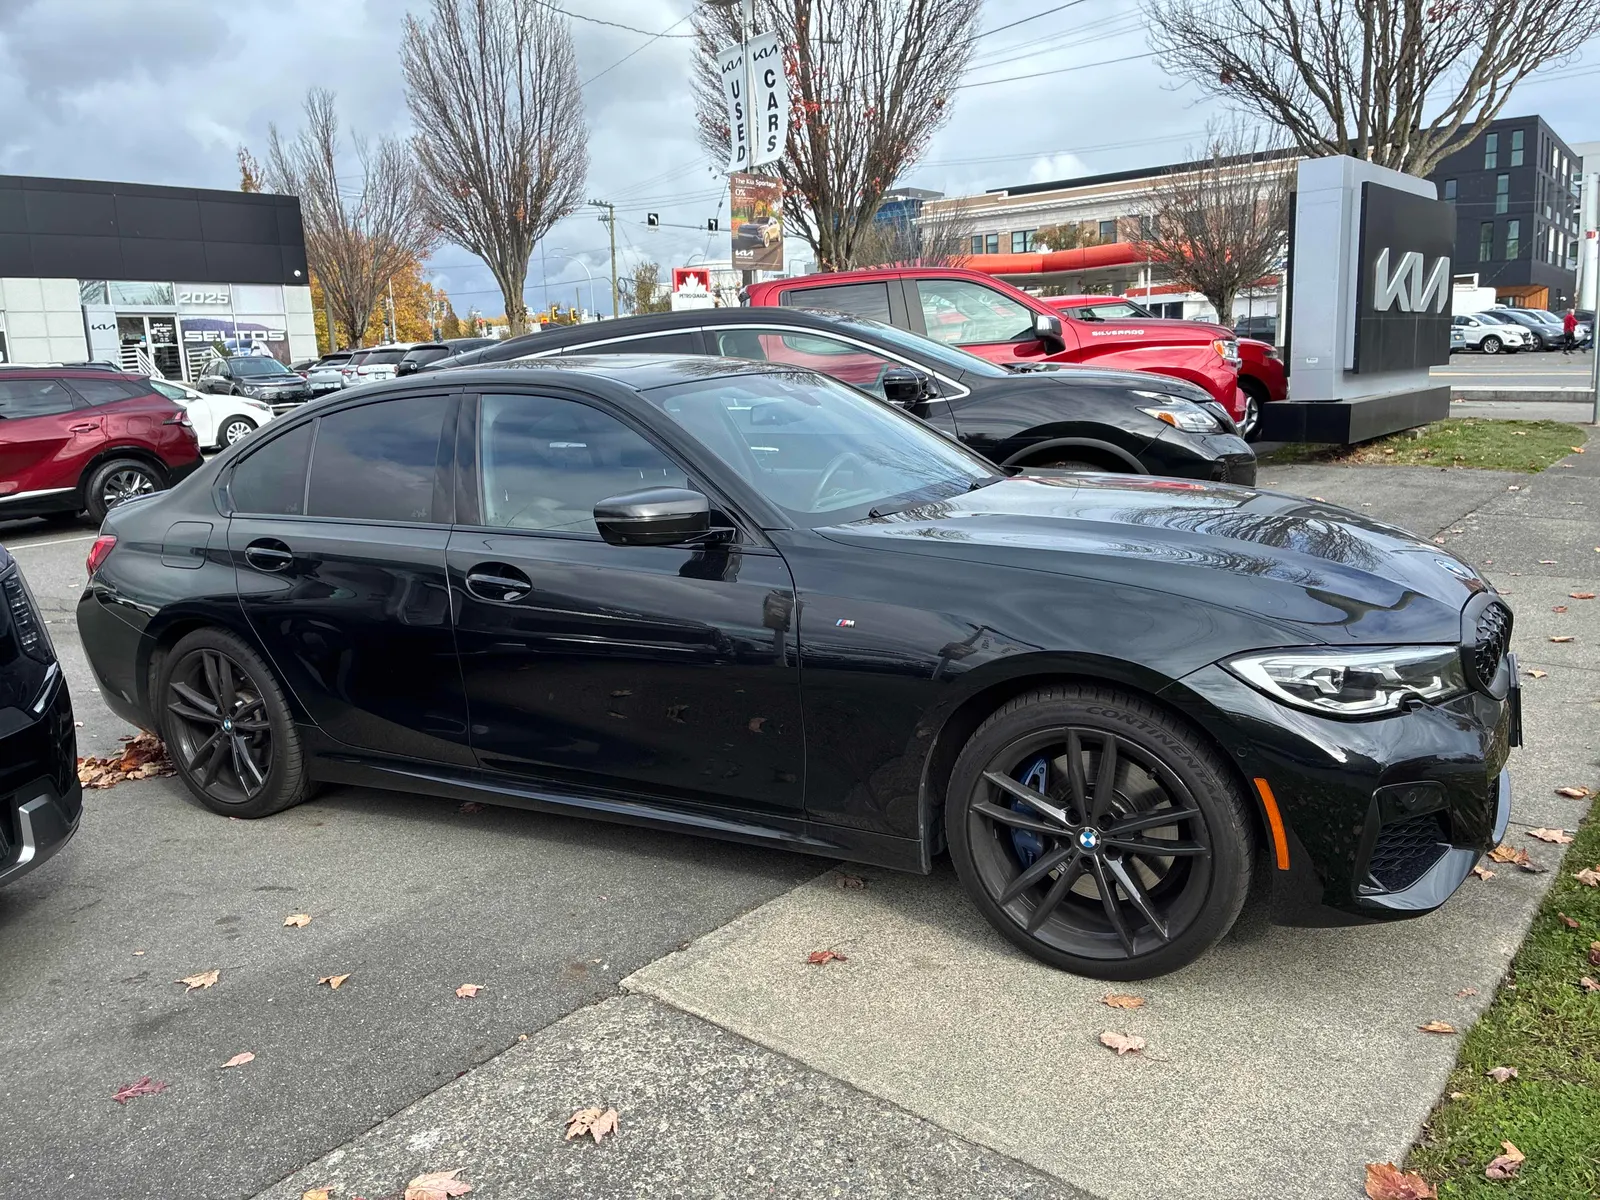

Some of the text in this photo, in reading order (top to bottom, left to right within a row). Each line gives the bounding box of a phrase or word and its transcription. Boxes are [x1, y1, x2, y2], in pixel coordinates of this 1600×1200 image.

[753, 44, 778, 62] KIA
[764, 69, 779, 152] CARS
[731, 79, 746, 163] USED
[735, 177, 746, 185] The
[755, 179, 777, 189] Sportage
[735, 188, 746, 197] 0%
[735, 249, 754, 257] KIA
[1374, 247, 1451, 314] KIA
[180, 292, 230, 305] 2025
[91, 323, 117, 331] KIA
[1091, 329, 1145, 337] SILVERADO
[183, 330, 286, 342] SELTOS
[1086, 705, 1223, 806] CONTINENTAL
